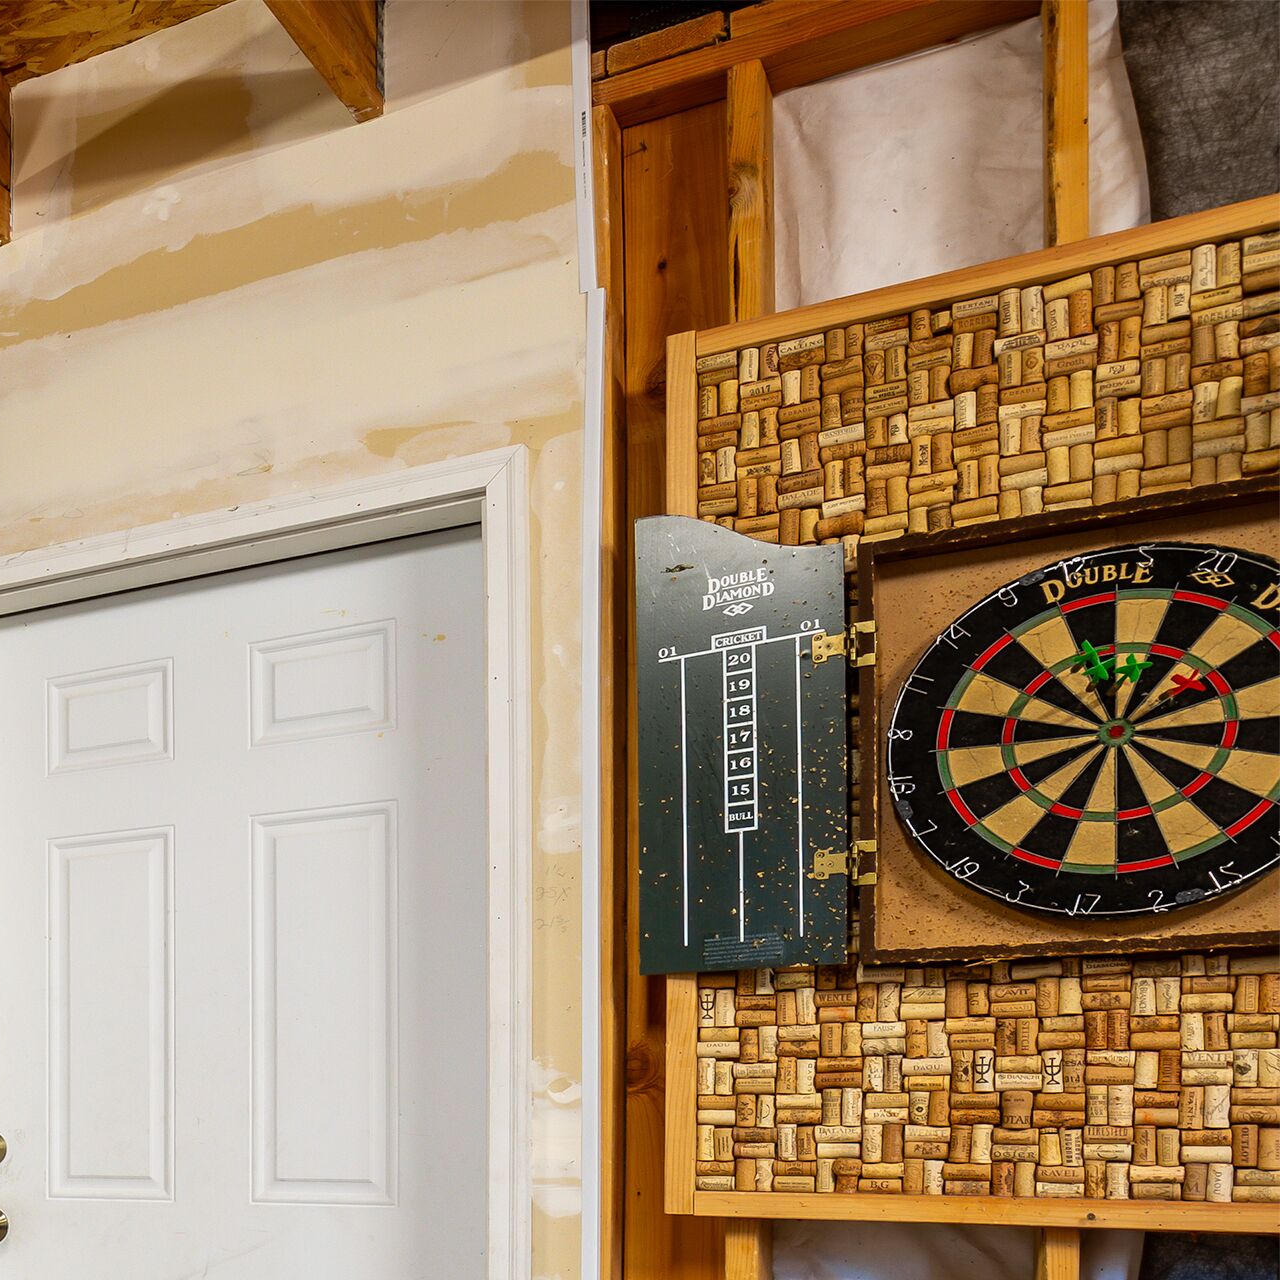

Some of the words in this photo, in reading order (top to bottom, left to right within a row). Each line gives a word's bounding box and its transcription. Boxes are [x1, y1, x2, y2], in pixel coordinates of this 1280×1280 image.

[780, 339, 823, 354] CALLING
[749, 385, 771, 396] 2017
[1197, 548, 1238, 574] 20
[707, 567, 767, 594] DOUBLE
[1040, 564, 1154, 604] DOUBLE
[702, 581, 775, 611] DIAMOND
[714, 631, 762, 648] CRICKET
[728, 652, 751, 665] 20
[729, 678, 751, 693] 19
[729, 704, 751, 718] 18
[729, 729, 752, 744] 17
[729, 756, 752, 770] 16
[731, 783, 751, 797] 15
[729, 811, 754, 822] BULL
[818, 993, 852, 1002] WENTE
[995, 989, 1030, 998] CAVIT
[1187, 1053, 1233, 1062] WENTE
[1241, 1127, 1249, 1163] OUTLOT
[1214, 1172, 1222, 1195] DAOU
